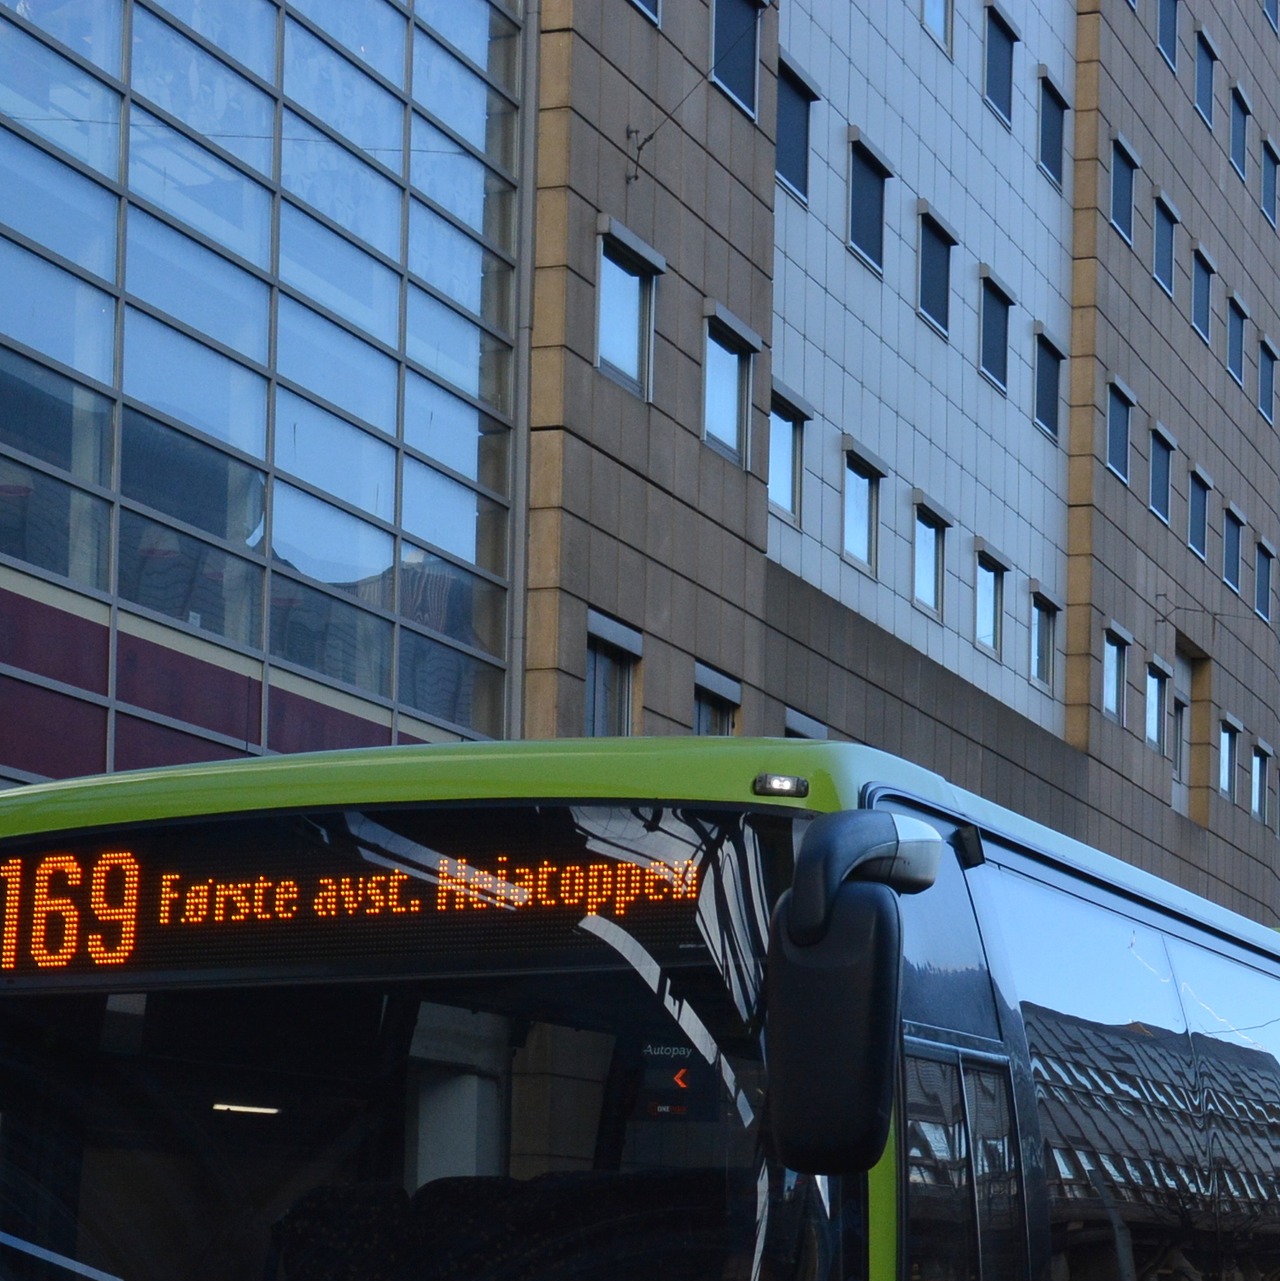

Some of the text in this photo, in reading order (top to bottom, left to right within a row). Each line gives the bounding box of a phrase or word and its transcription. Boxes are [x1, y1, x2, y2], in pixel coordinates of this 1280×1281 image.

[0, 852, 139, 969] 169
[159, 873, 298, 924] Første
[313, 868, 419, 916] avst.
[643, 1044, 692, 1059] Autopay
